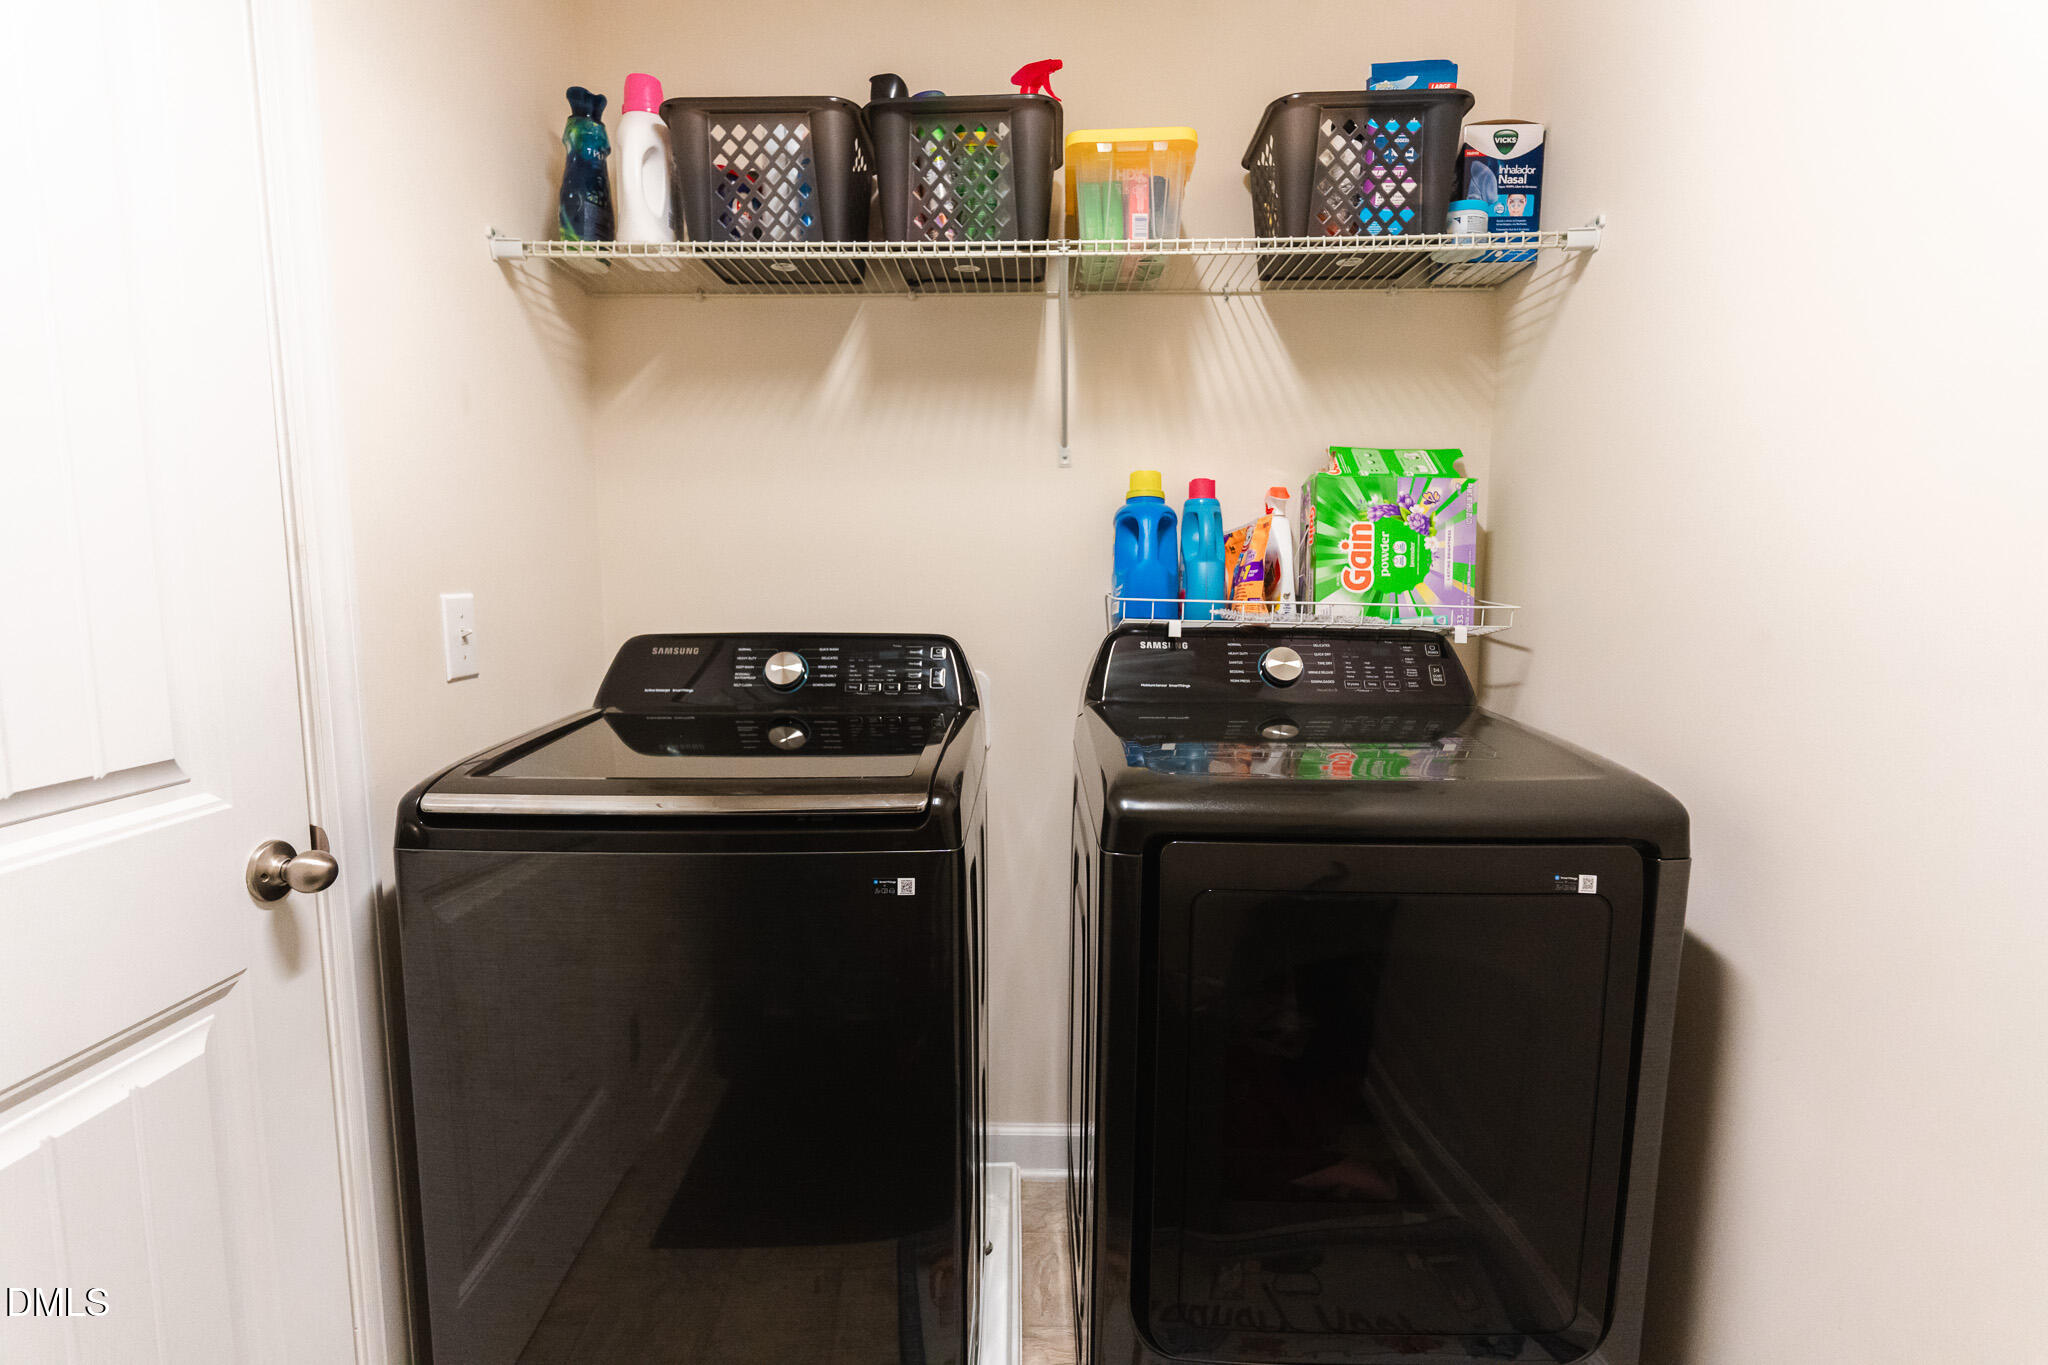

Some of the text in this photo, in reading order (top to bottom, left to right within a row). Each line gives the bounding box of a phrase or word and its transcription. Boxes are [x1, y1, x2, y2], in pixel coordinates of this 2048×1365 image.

[1498, 164, 1536, 175] Inhalador
[1498, 175, 1527, 185] Nasal
[1340, 521, 1374, 592] Gain
[1381, 531, 1391, 577] powder
[652, 647, 700, 655] SAMSUNG
